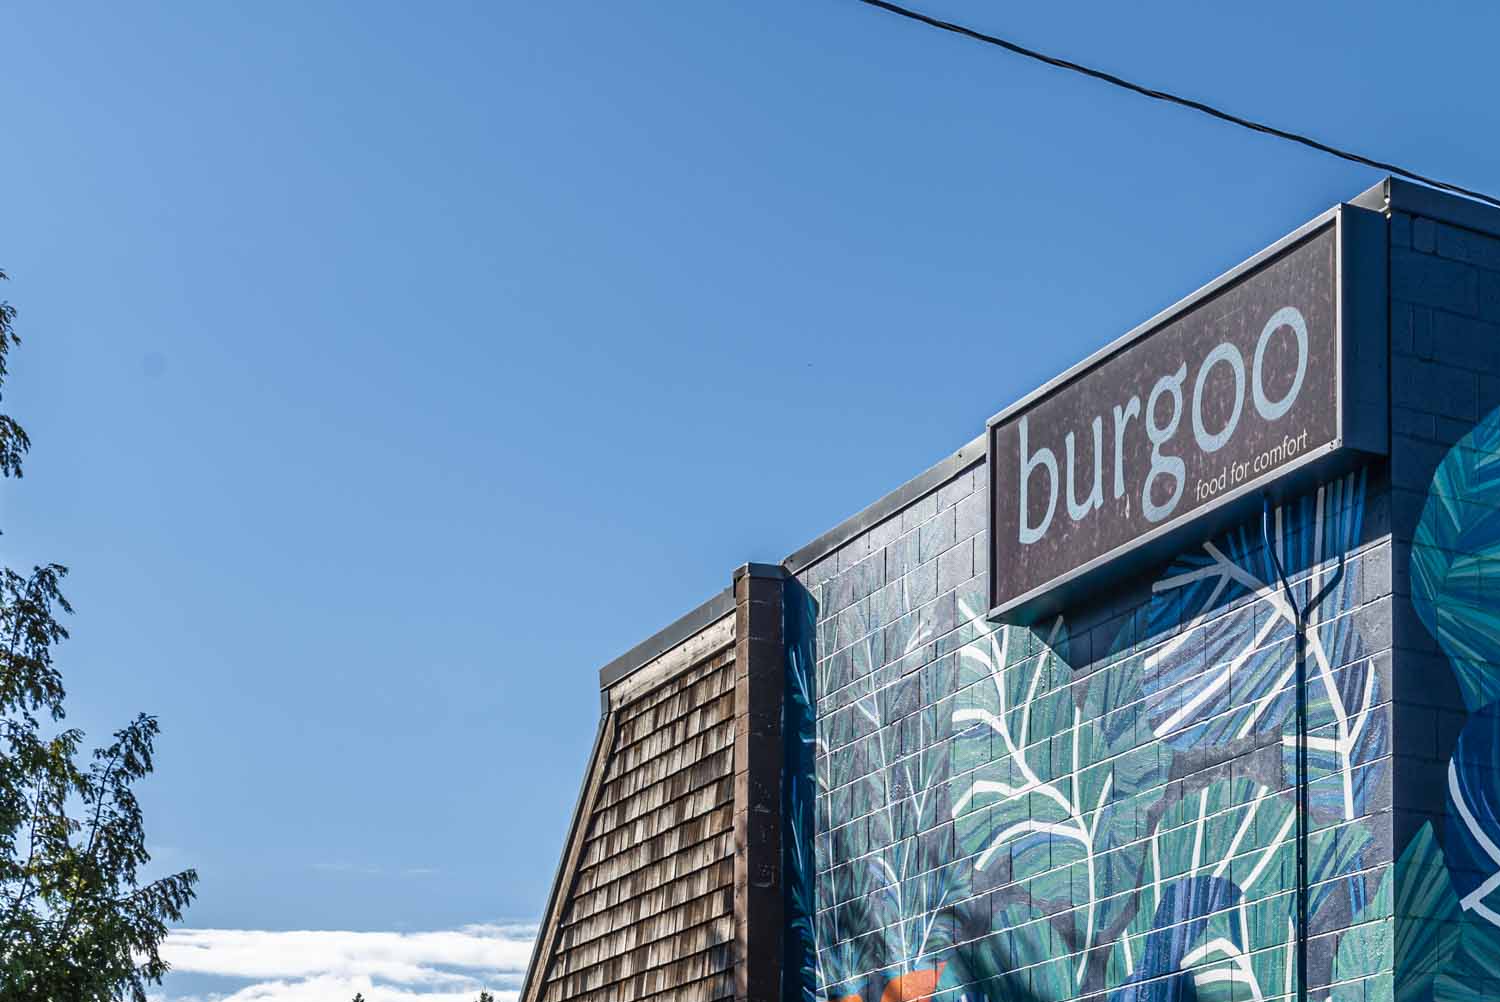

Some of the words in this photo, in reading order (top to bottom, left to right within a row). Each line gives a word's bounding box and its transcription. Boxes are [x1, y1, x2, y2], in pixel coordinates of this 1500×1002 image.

[1017, 305, 1309, 545] burgoo
[1196, 466, 1226, 502] food
[1231, 461, 1250, 484] for
[1253, 427, 1308, 473] comfort
